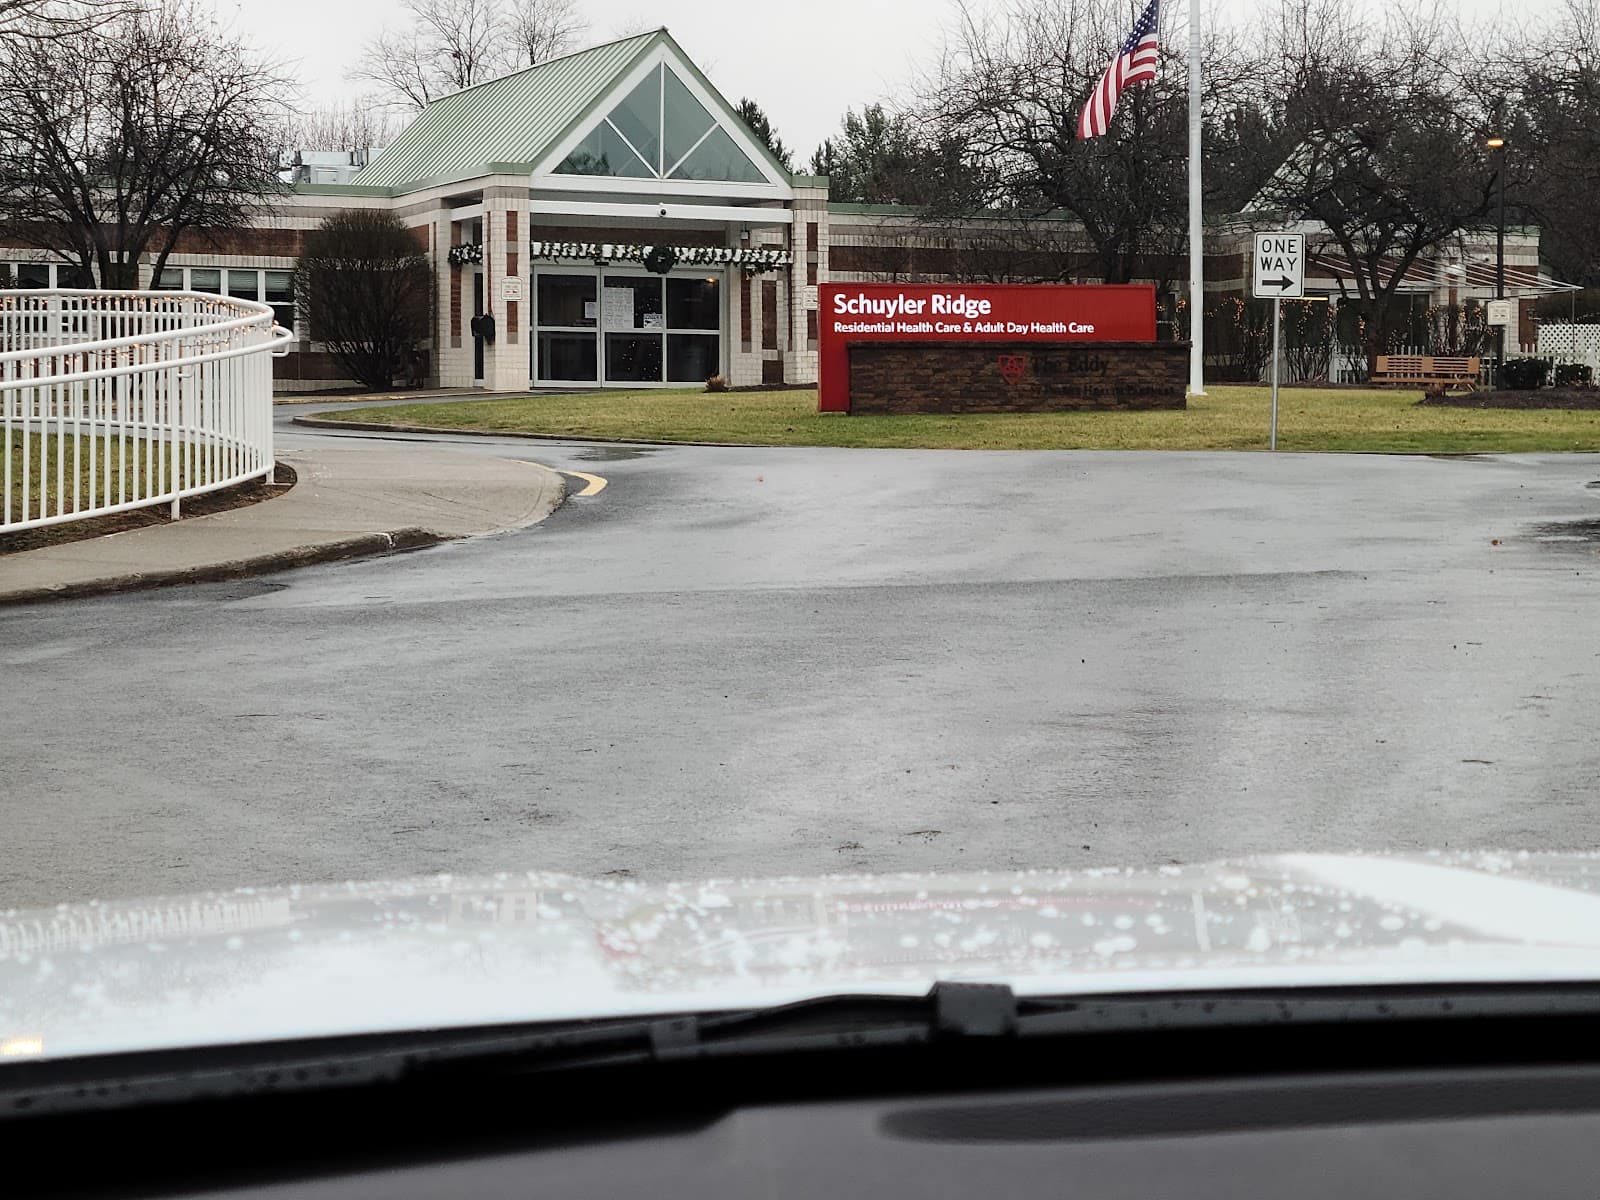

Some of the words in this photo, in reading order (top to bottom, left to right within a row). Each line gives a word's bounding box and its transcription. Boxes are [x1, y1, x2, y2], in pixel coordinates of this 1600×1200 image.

[1262, 239, 1297, 253] ONE
[1260, 256, 1297, 271] WAY
[833, 293, 926, 318] Schuyler
[931, 293, 992, 318] Ridge
[834, 321, 895, 333] Residential
[896, 321, 934, 333] Health
[935, 321, 962, 333] Care
[963, 321, 973, 333] &
[974, 321, 1005, 333] Adult
[1006, 321, 1029, 335] Day
[1030, 321, 1067, 333] Health
[1068, 321, 1095, 333] Care
